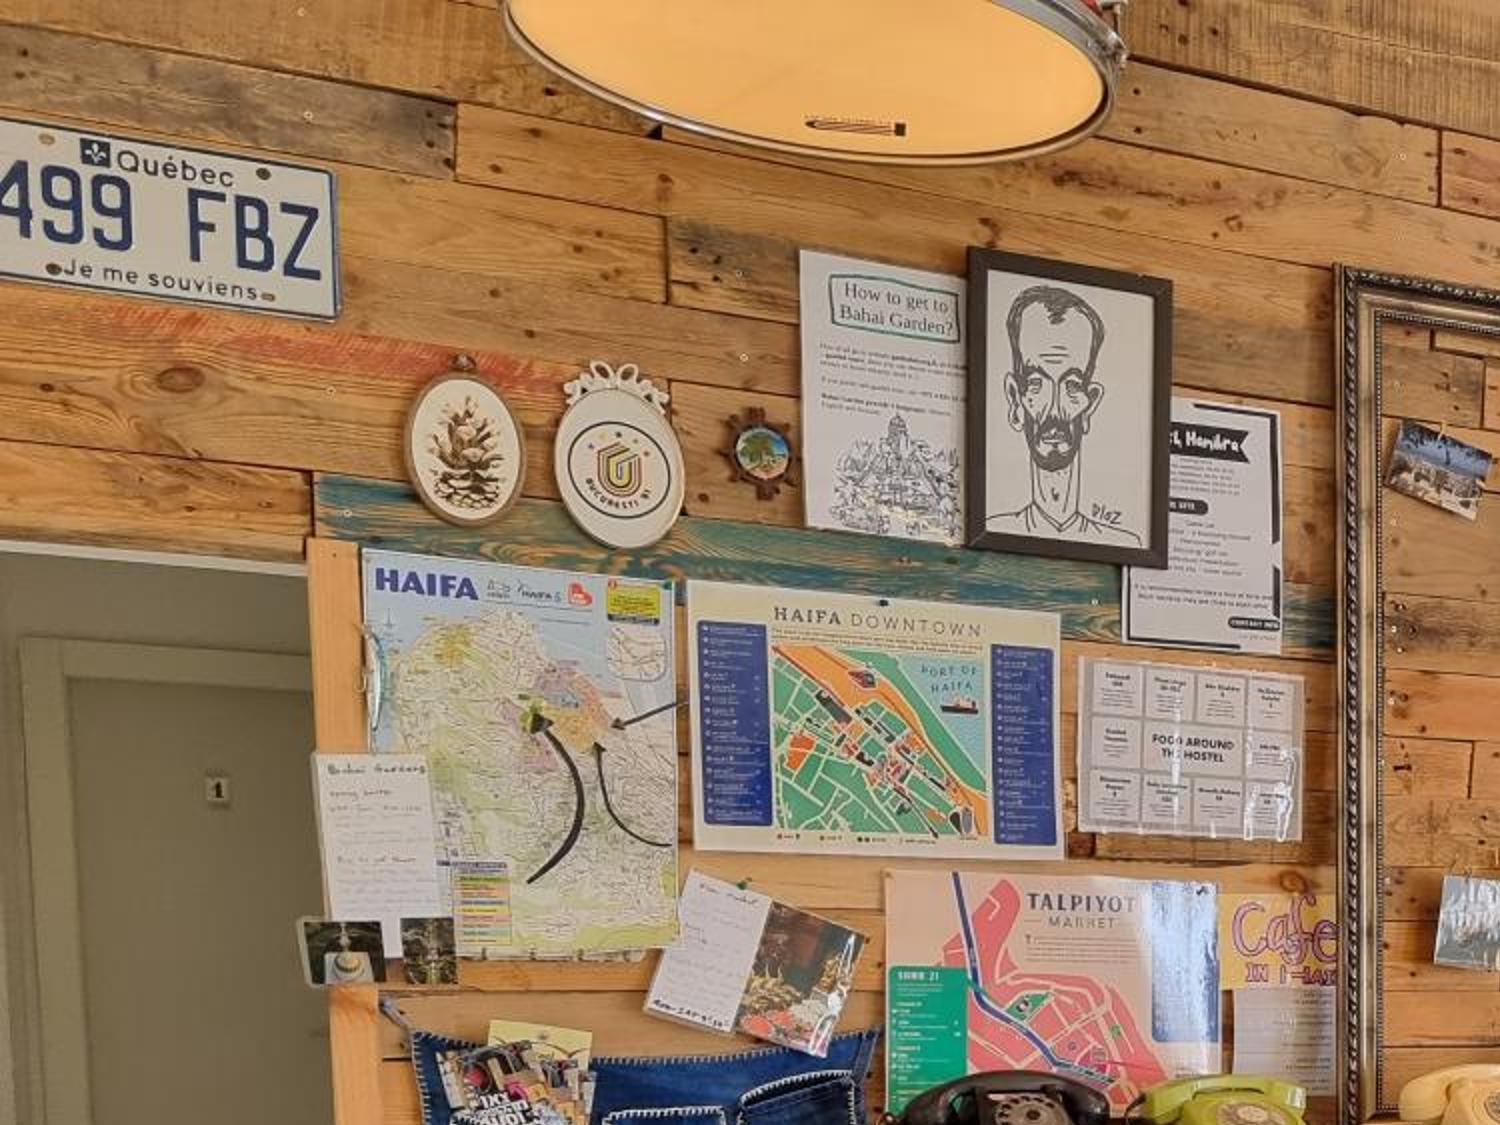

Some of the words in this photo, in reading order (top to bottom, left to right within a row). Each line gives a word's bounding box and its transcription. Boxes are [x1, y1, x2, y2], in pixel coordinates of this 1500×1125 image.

[117, 150, 235, 188] Québec
[0, 159, 134, 252] 499
[187, 187, 322, 282] FBZ
[63, 259, 94, 279] Je
[103, 265, 139, 286] me
[148, 271, 258, 302] souviens
[845, 281, 881, 302] How
[886, 291, 901, 305] to
[933, 300, 949, 314] to
[839, 304, 885, 326] Bahai
[889, 313, 953, 336] Garden?
[375, 567, 479, 601] HAIFA
[773, 606, 841, 625] HAIFA
[850, 613, 981, 637] DOWNTOWN
[1183, 750, 1224, 763] HOSTEL
[1185, 737, 1235, 751] AROUND
[1026, 892, 1138, 914] TALPIYOT
